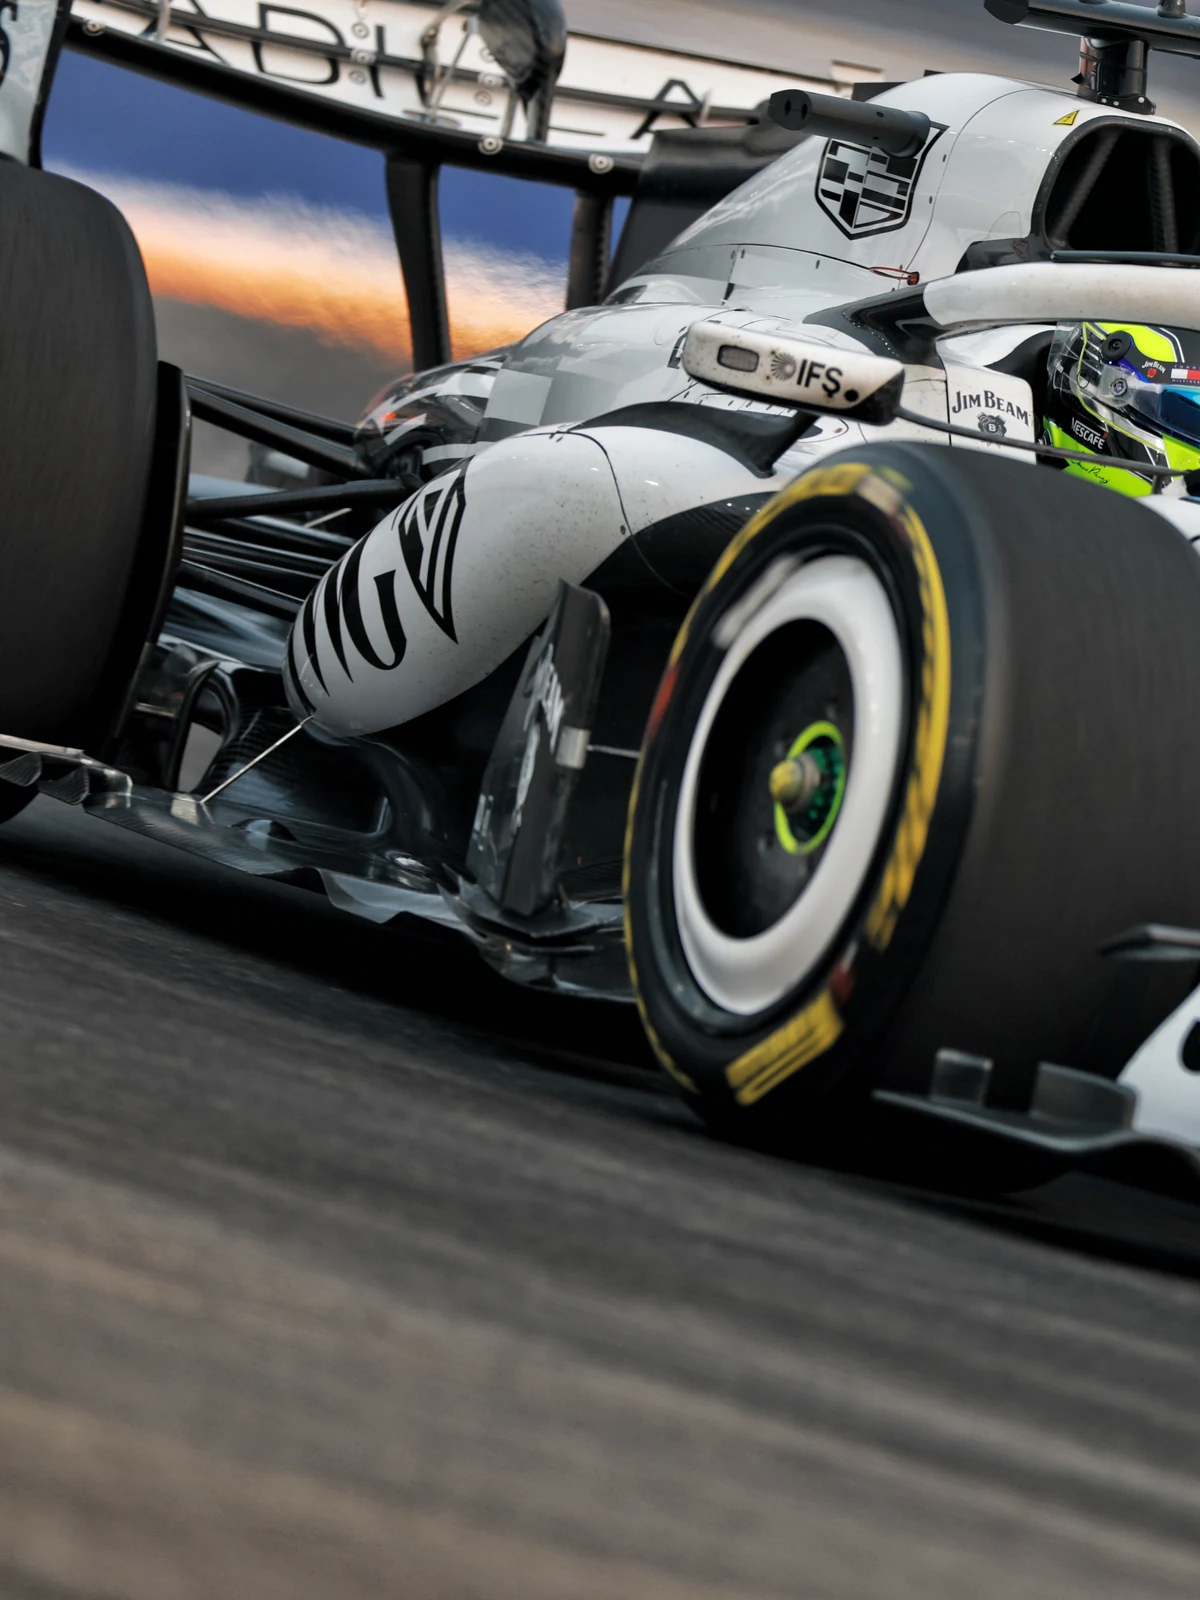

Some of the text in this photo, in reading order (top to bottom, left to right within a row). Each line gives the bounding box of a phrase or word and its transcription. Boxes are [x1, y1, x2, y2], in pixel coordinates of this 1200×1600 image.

[796, 358, 844, 396] IFS
[951, 389, 1030, 428] JIM BEAM
